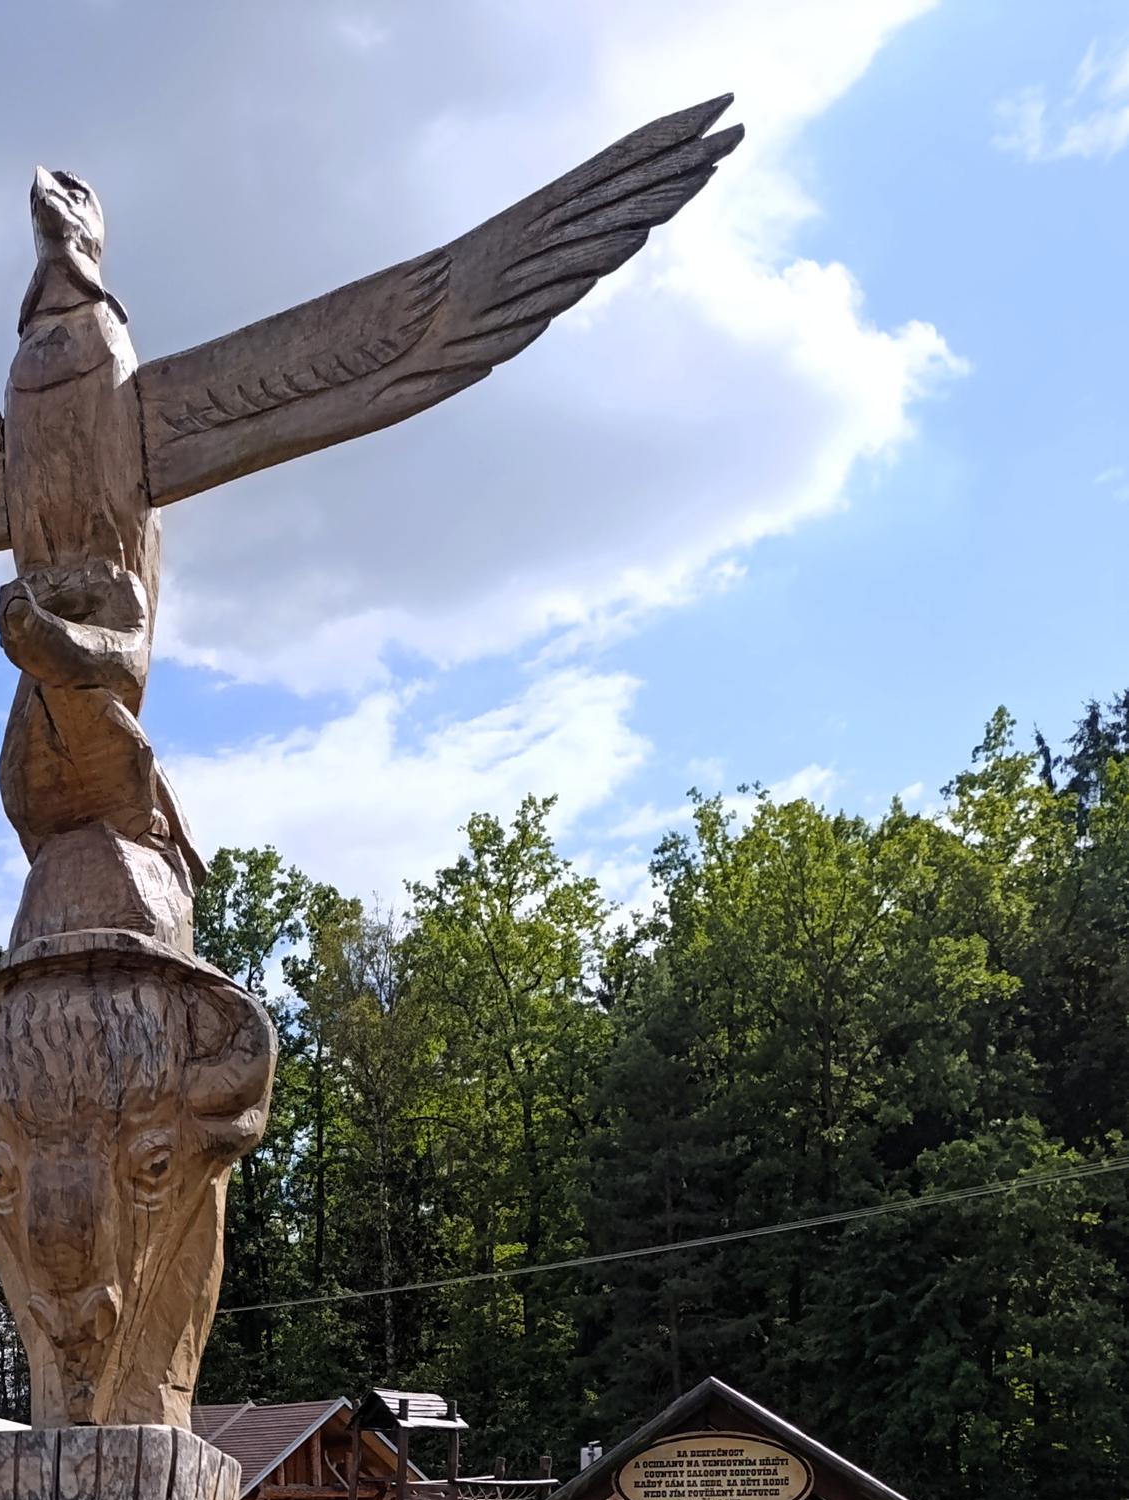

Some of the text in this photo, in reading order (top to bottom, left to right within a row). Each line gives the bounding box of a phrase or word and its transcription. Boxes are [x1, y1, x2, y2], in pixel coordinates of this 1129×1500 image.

[642, 1460, 684, 1469] OCHRANU
[686, 1460, 700, 1468] NA
[644, 1470, 685, 1478] COUNTRY
[687, 1469, 728, 1477] SALOONU
[727, 1479, 738, 1487] ZA
[762, 1476, 789, 1486] RODIČ
[643, 1490, 667, 1498] NEBO
